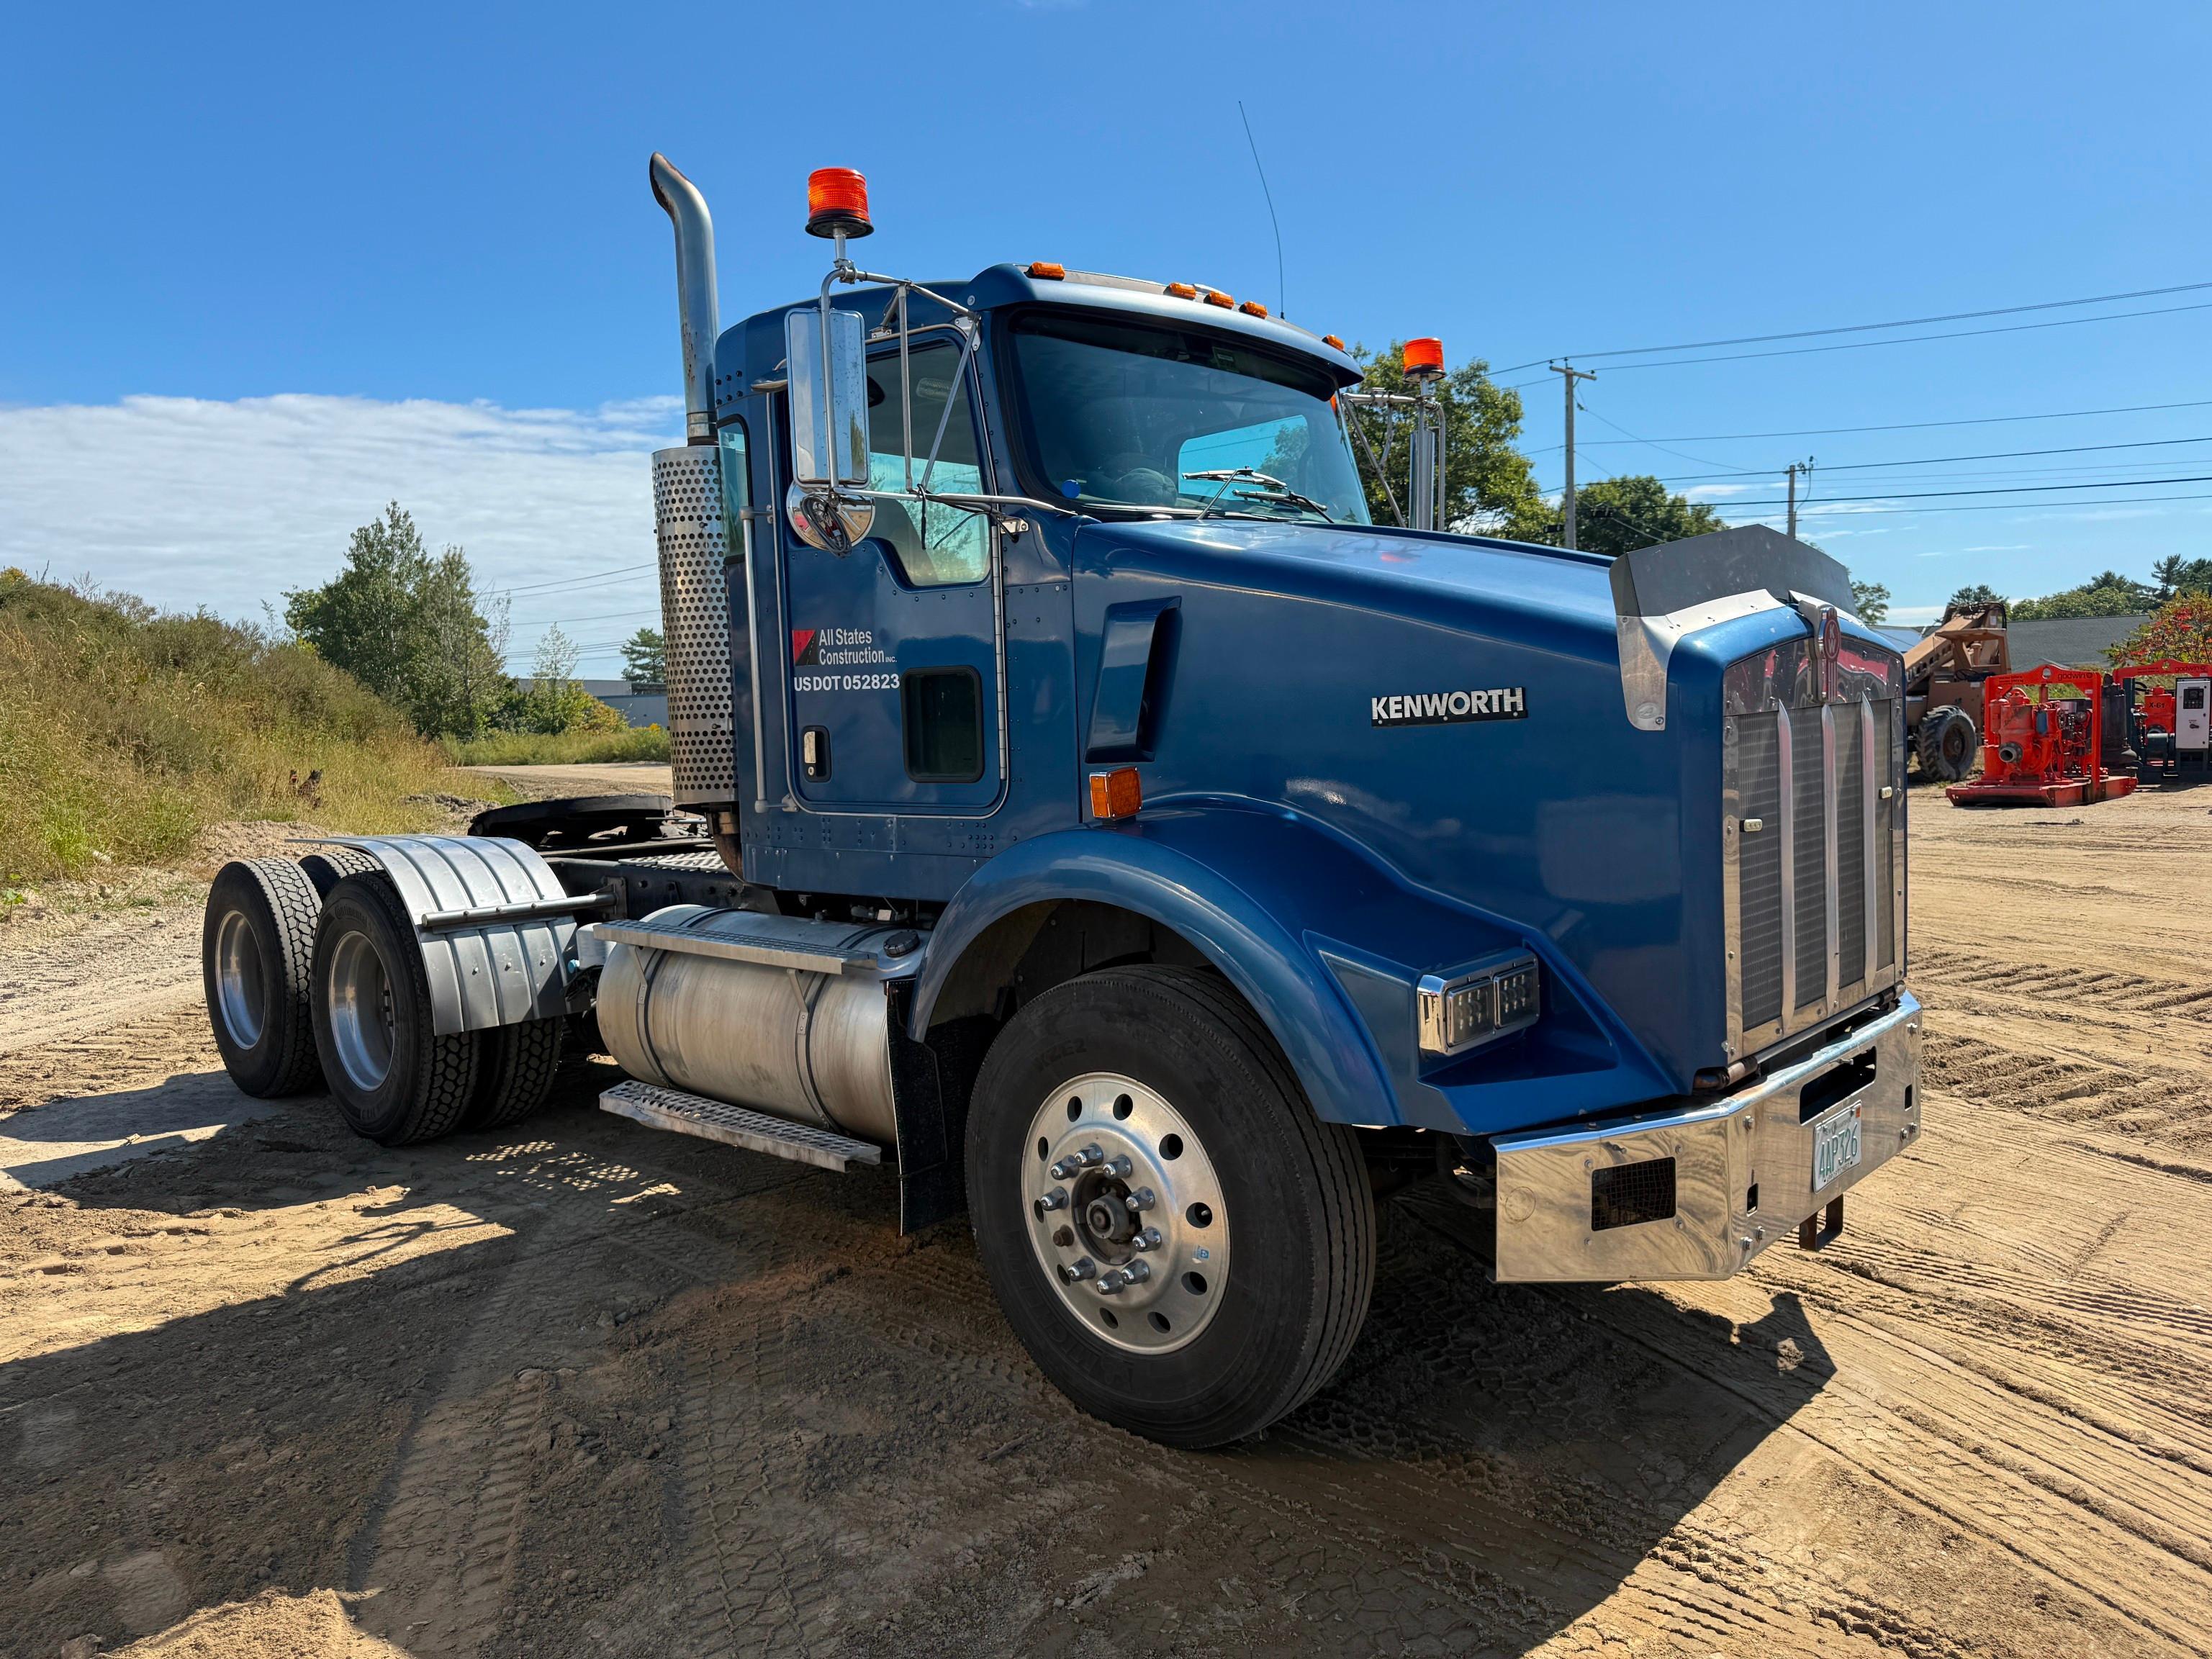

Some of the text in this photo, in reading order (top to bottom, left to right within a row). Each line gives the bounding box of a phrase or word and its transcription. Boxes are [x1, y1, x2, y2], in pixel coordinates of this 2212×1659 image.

[818, 628, 872, 646] All States
[818, 647, 885, 665] Construction
[843, 673, 900, 690] 052823
[2057, 672, 2085, 681] godwin
[1371, 687, 1523, 720] KENWORTH
